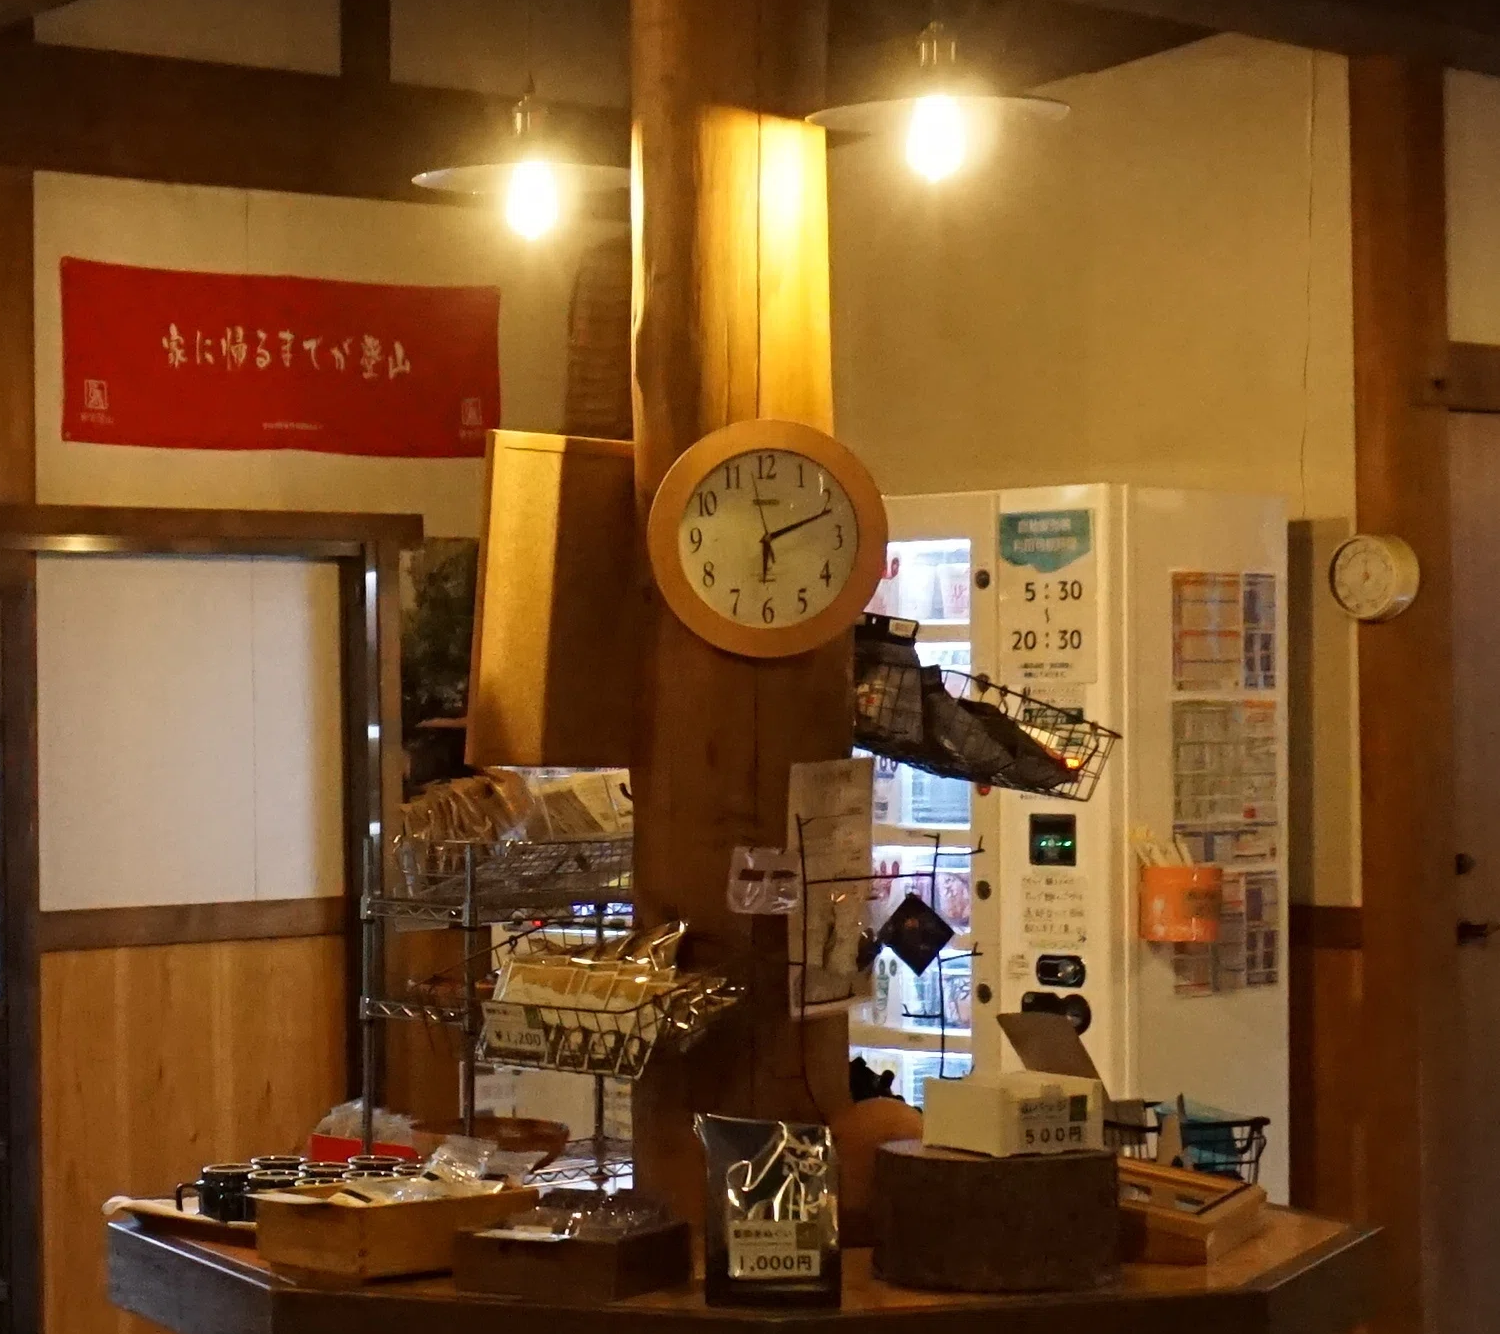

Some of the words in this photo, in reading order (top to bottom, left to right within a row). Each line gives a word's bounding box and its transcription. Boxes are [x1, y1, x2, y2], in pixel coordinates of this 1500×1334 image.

[161, 322, 411, 380] 家に帰るまでが登山
[724, 464, 742, 490] 11
[756, 455, 776, 480] 12
[797, 464, 805, 488] 1
[698, 490, 718, 517] 10
[823, 488, 832, 514] 2
[690, 527, 702, 553] 9
[834, 524, 844, 550] 3
[702, 561, 715, 588] 8
[819, 561, 832, 587] 4
[729, 588, 741, 616] 7
[761, 597, 775, 624] 6
[797, 588, 807, 615] 5
[1025, 1126, 1082, 1144] 500円
[740, 1255, 812, 1271] 1,000円
